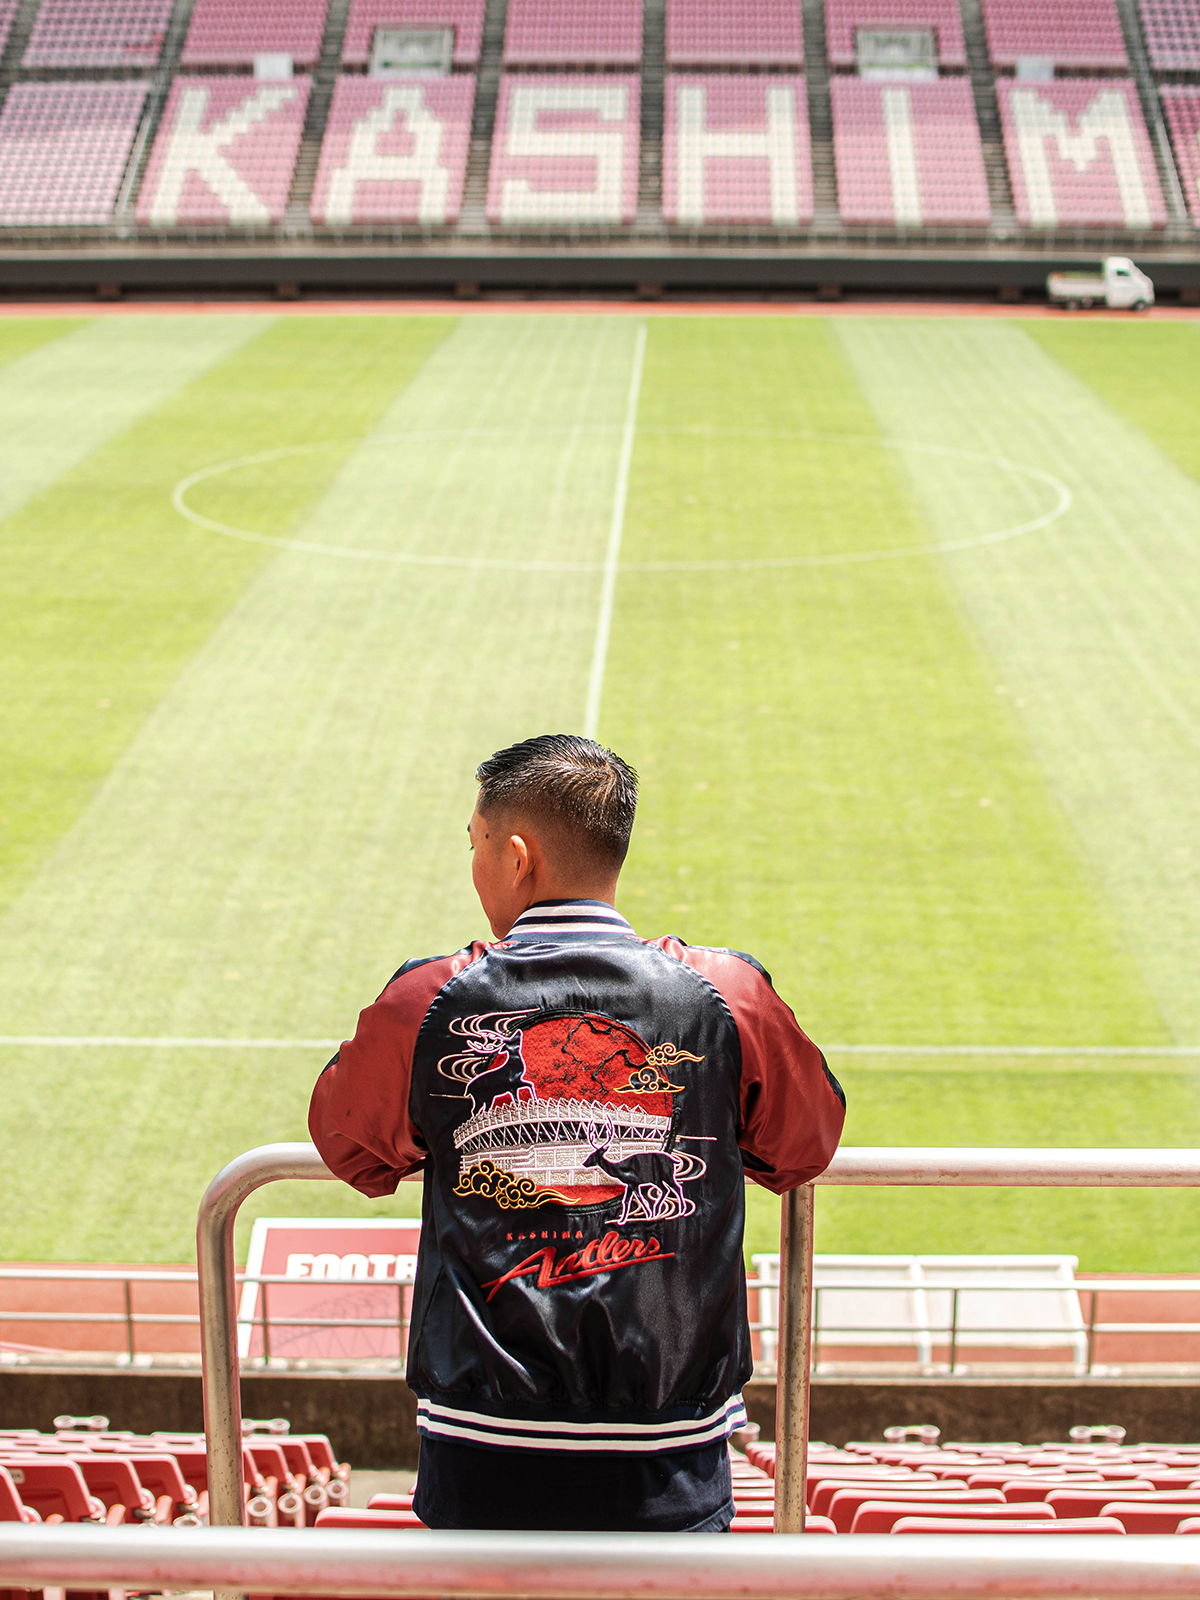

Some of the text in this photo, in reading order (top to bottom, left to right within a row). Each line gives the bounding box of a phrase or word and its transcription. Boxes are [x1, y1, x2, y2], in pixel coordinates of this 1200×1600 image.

[150, 84, 1200, 227] KASHIM
[480, 1231, 675, 1303] Antlers
[506, 1230, 583, 1241] KASHIMA
